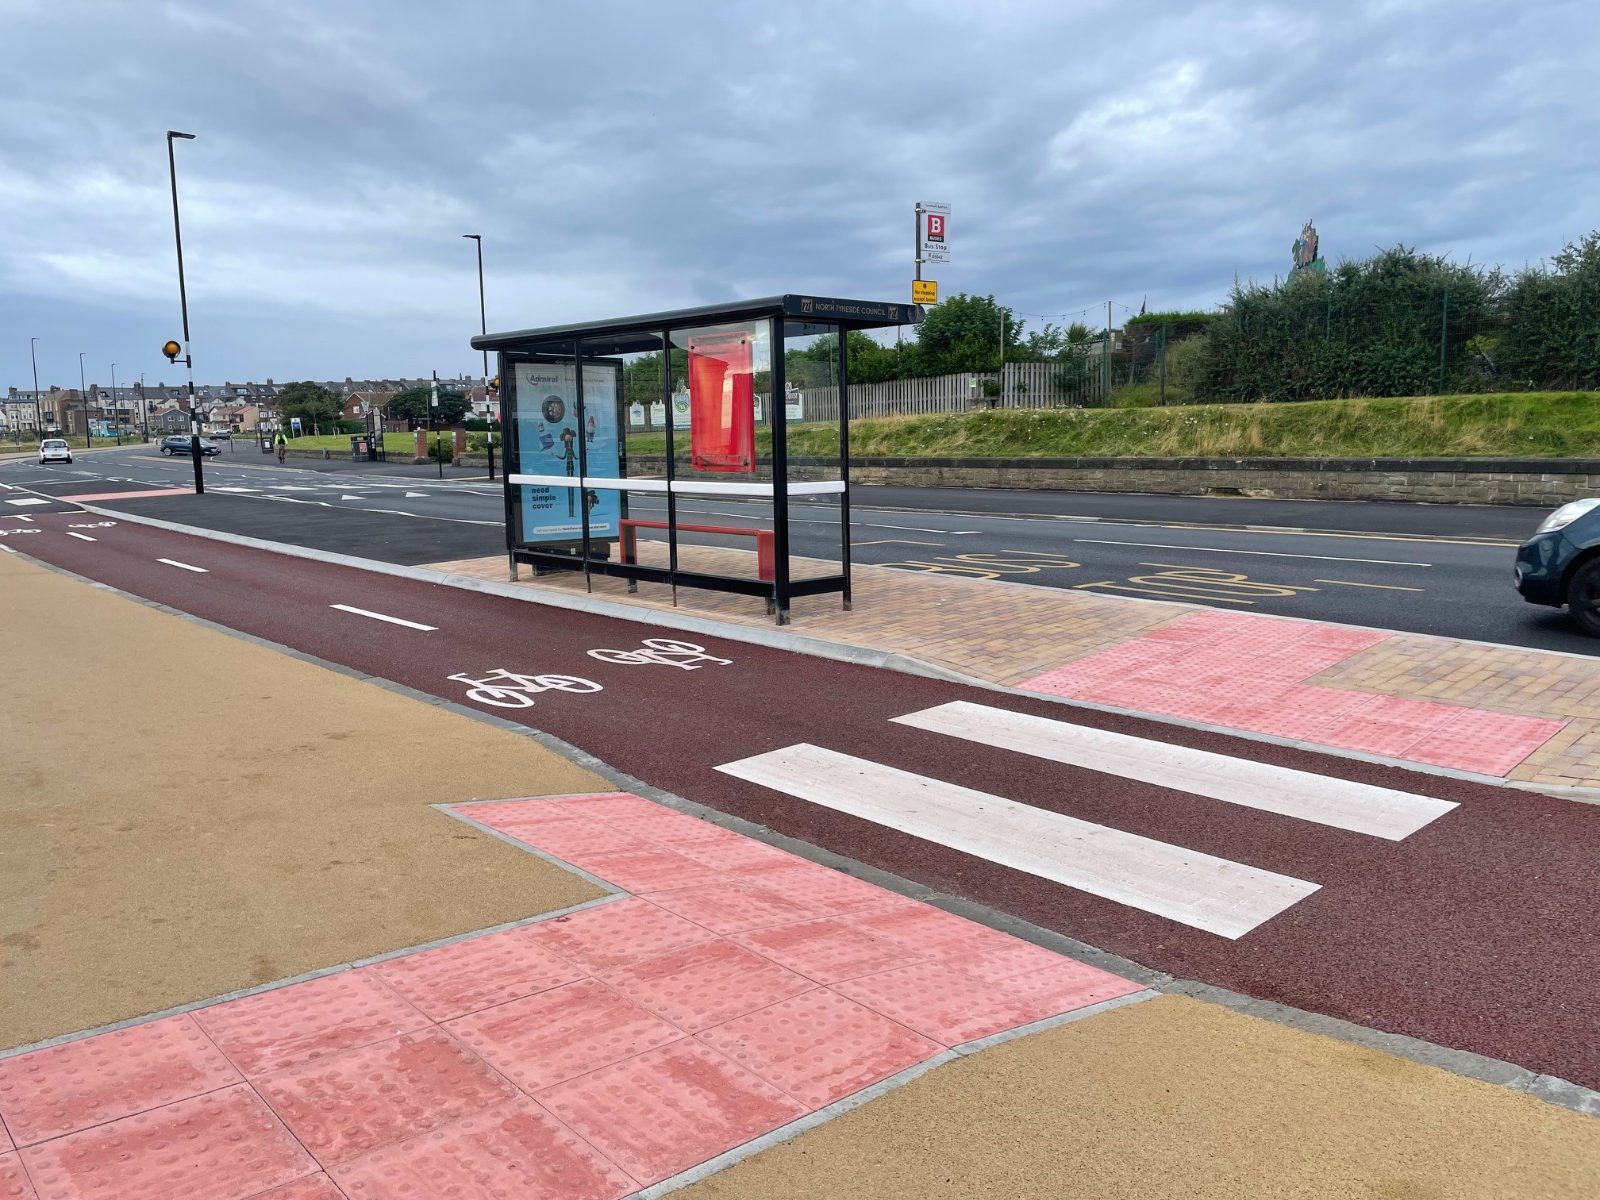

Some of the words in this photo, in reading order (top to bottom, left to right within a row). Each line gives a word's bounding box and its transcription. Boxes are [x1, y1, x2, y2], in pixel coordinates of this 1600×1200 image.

[931, 217, 941, 233] B
[924, 242, 934, 250] Bus
[935, 243, 947, 251] Stop
[815, 303, 835, 312] NORTH
[835, 304, 860, 314] TYNESIDE
[861, 307, 885, 316] COUNCIL
[528, 374, 559, 384] Admiral
[531, 486, 550, 494] need
[531, 494, 557, 503] simple
[1073, 570, 1320, 605] TOP
